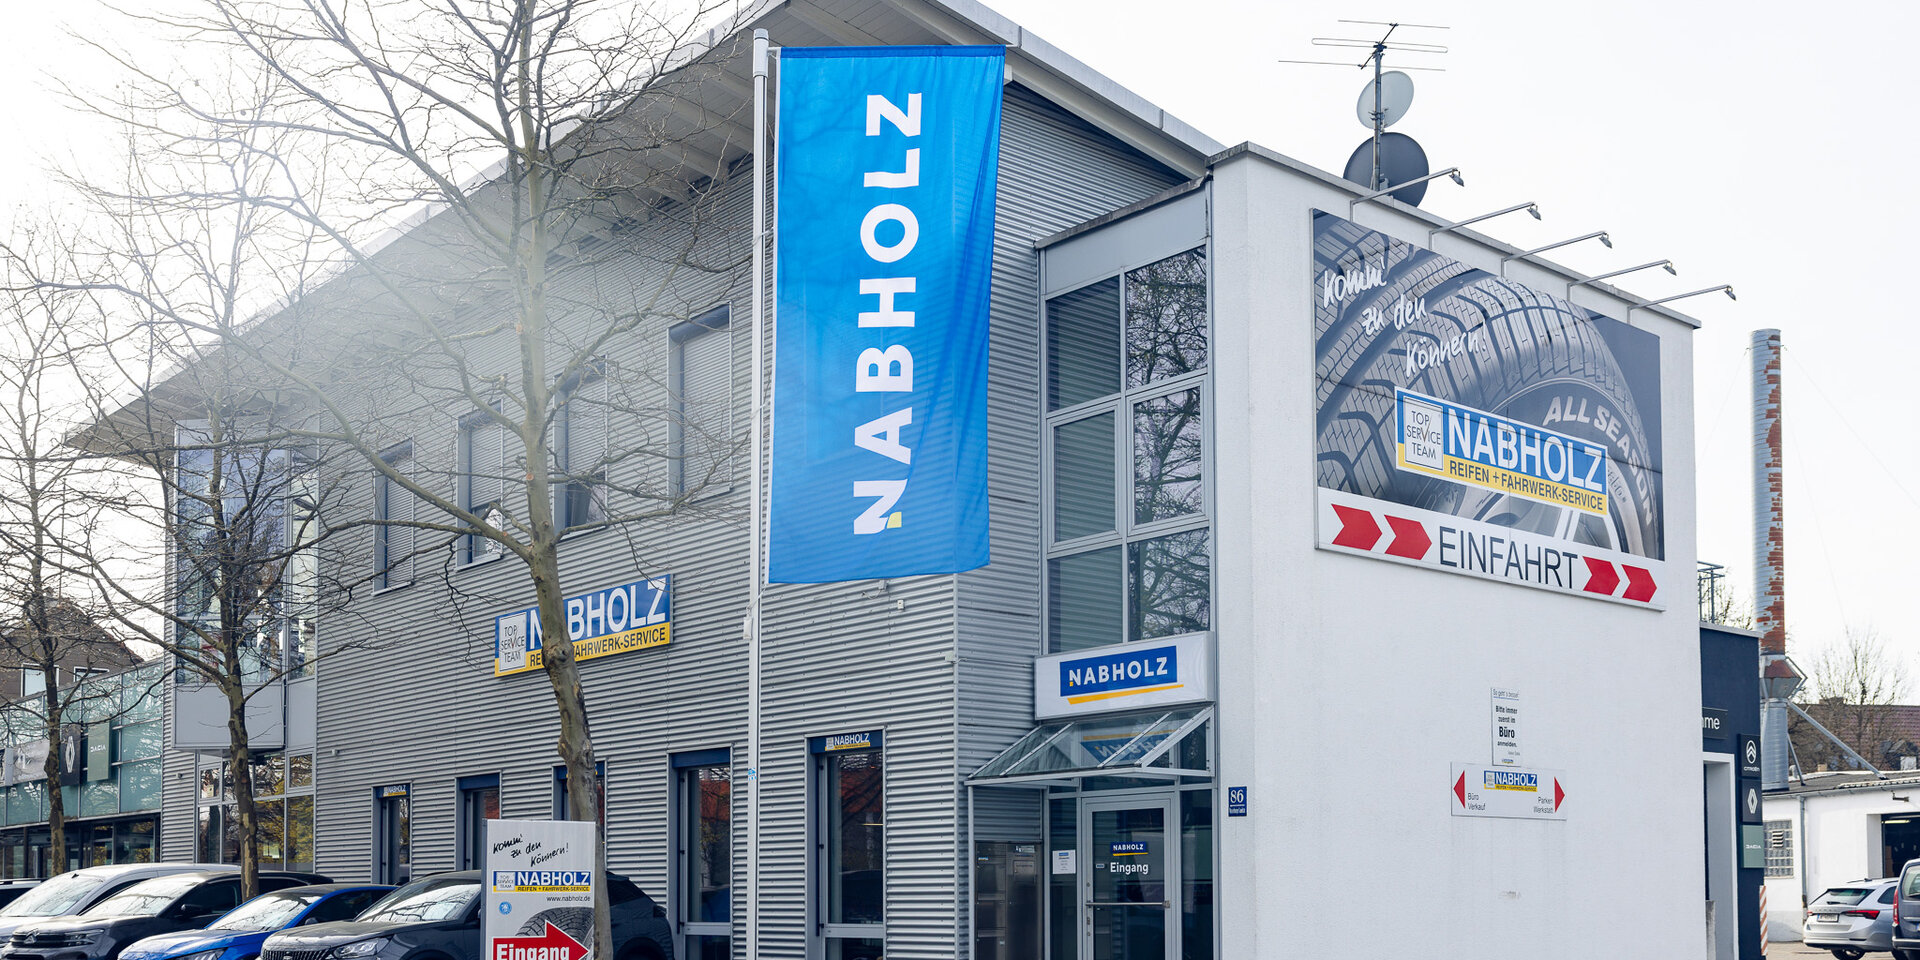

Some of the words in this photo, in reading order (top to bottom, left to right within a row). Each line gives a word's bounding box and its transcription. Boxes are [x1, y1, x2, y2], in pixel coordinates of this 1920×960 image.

[854, 93, 922, 534] NABHOLZ
[1362, 307, 1385, 336] zu
[1394, 294, 1426, 331] den
[1406, 319, 1487, 377] Könnern!
[1411, 411, 1430, 425] TOP
[1406, 425, 1441, 445] SERVICE
[1412, 442, 1437, 460] TEAM
[1448, 408, 1603, 492] NABHOLZ
[1542, 396, 1590, 426] ALL
[1593, 405, 1653, 526] SEASON
[1449, 460, 1490, 483] REIFEN
[1501, 473, 1604, 511] FAHRWERK-SERVICE
[1439, 526, 1578, 589] EINFAHRT
[530, 577, 666, 649] NBHOLZ
[504, 625, 518, 637] TOP
[501, 636, 525, 651] SERVICE
[573, 627, 666, 658] AHRWERK-SERVICE
[504, 651, 521, 663] TEAM
[1068, 656, 1168, 687] NABHOLZ
[834, 733, 870, 746] NABHOLZ
[1498, 726, 1515, 738] Büro
[1495, 772, 1537, 786] NABHOLZ
[1230, 789, 1244, 803] 86
[1467, 792, 1479, 800] Büro
[511, 849, 521, 858] zu
[525, 842, 541, 854] den
[1110, 862, 1149, 875] Eingang
[517, 872, 589, 886] NABHOLZ
[496, 943, 570, 960] Eingang
